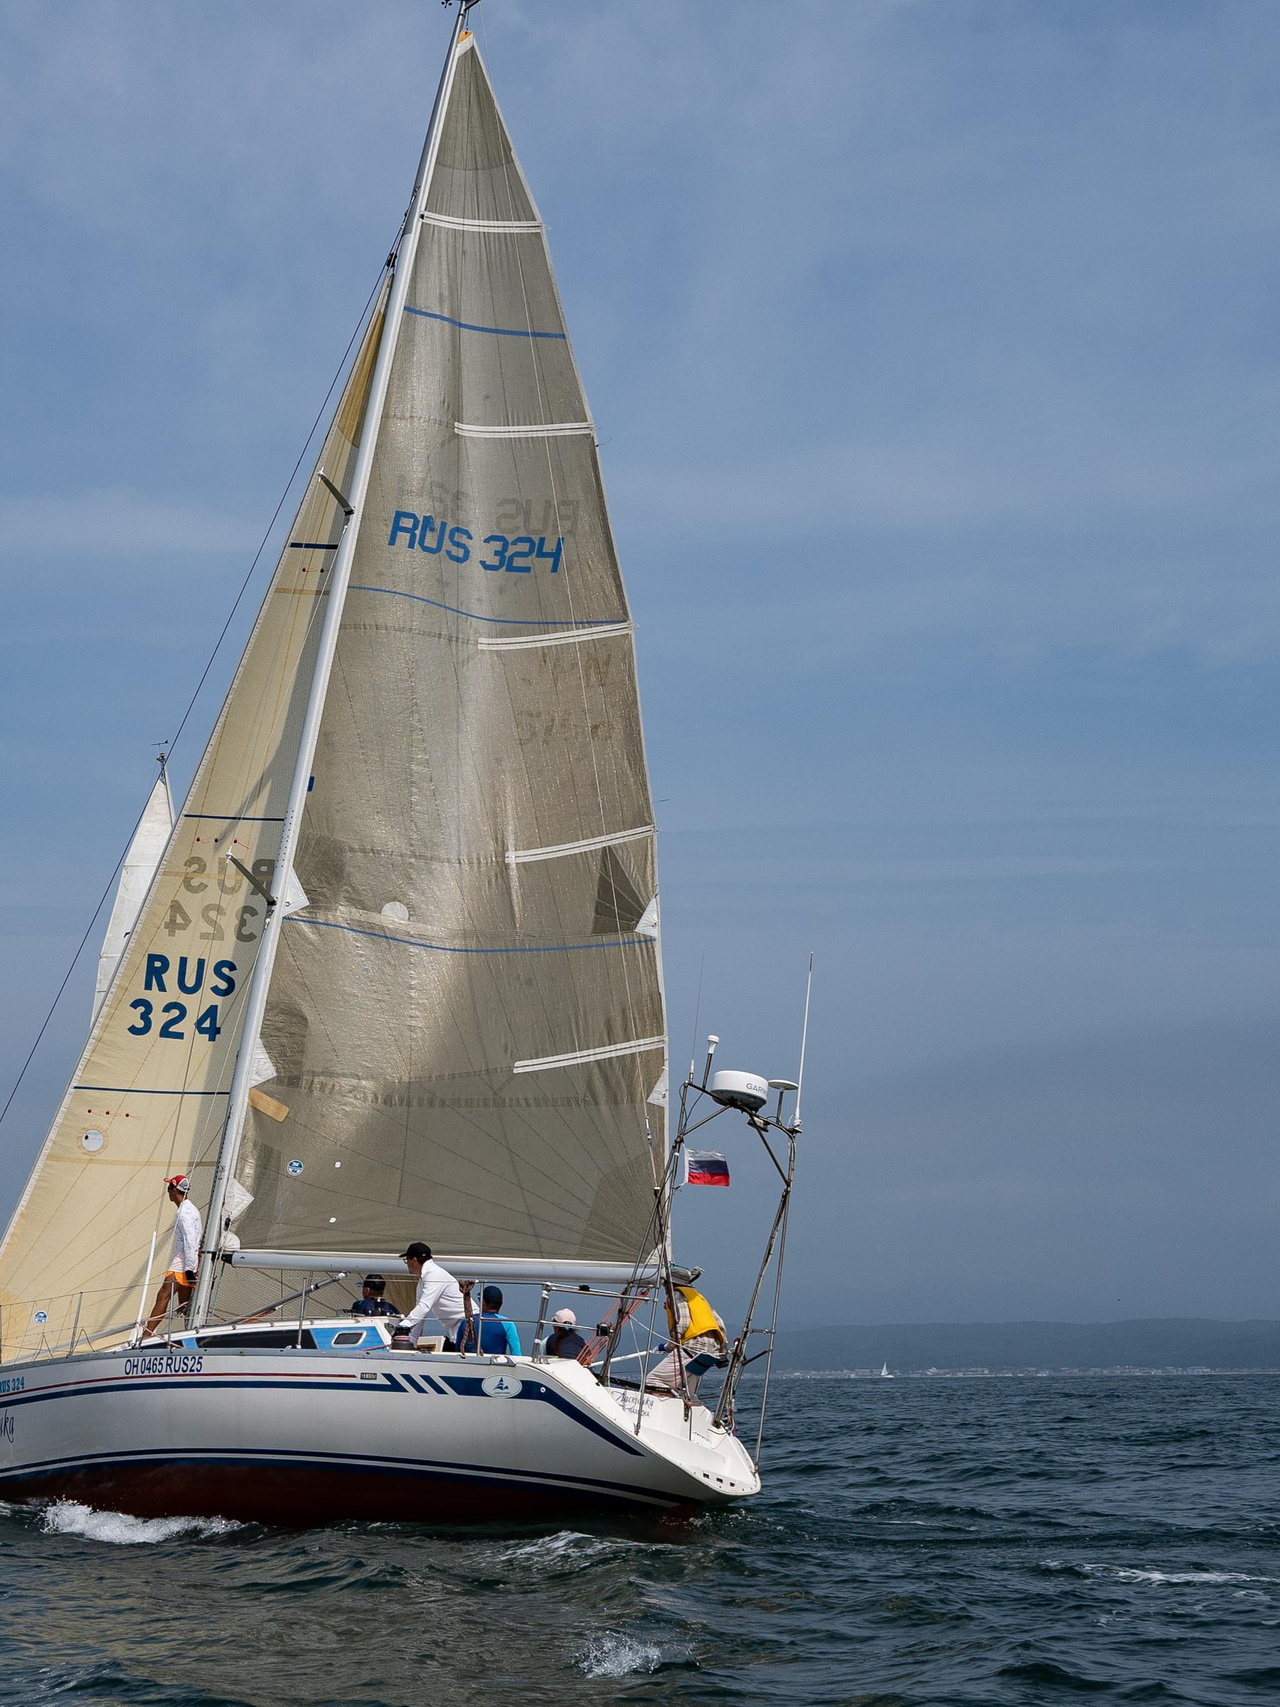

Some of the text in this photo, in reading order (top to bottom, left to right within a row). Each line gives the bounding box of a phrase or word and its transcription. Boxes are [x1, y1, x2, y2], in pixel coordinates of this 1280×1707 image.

[388, 510, 564, 573] RUS 324
[144, 953, 238, 997] RUS
[127, 998, 221, 1042] 324
[11, 1376, 25, 1391] 324
[140, 1357, 163, 1374] 0465
